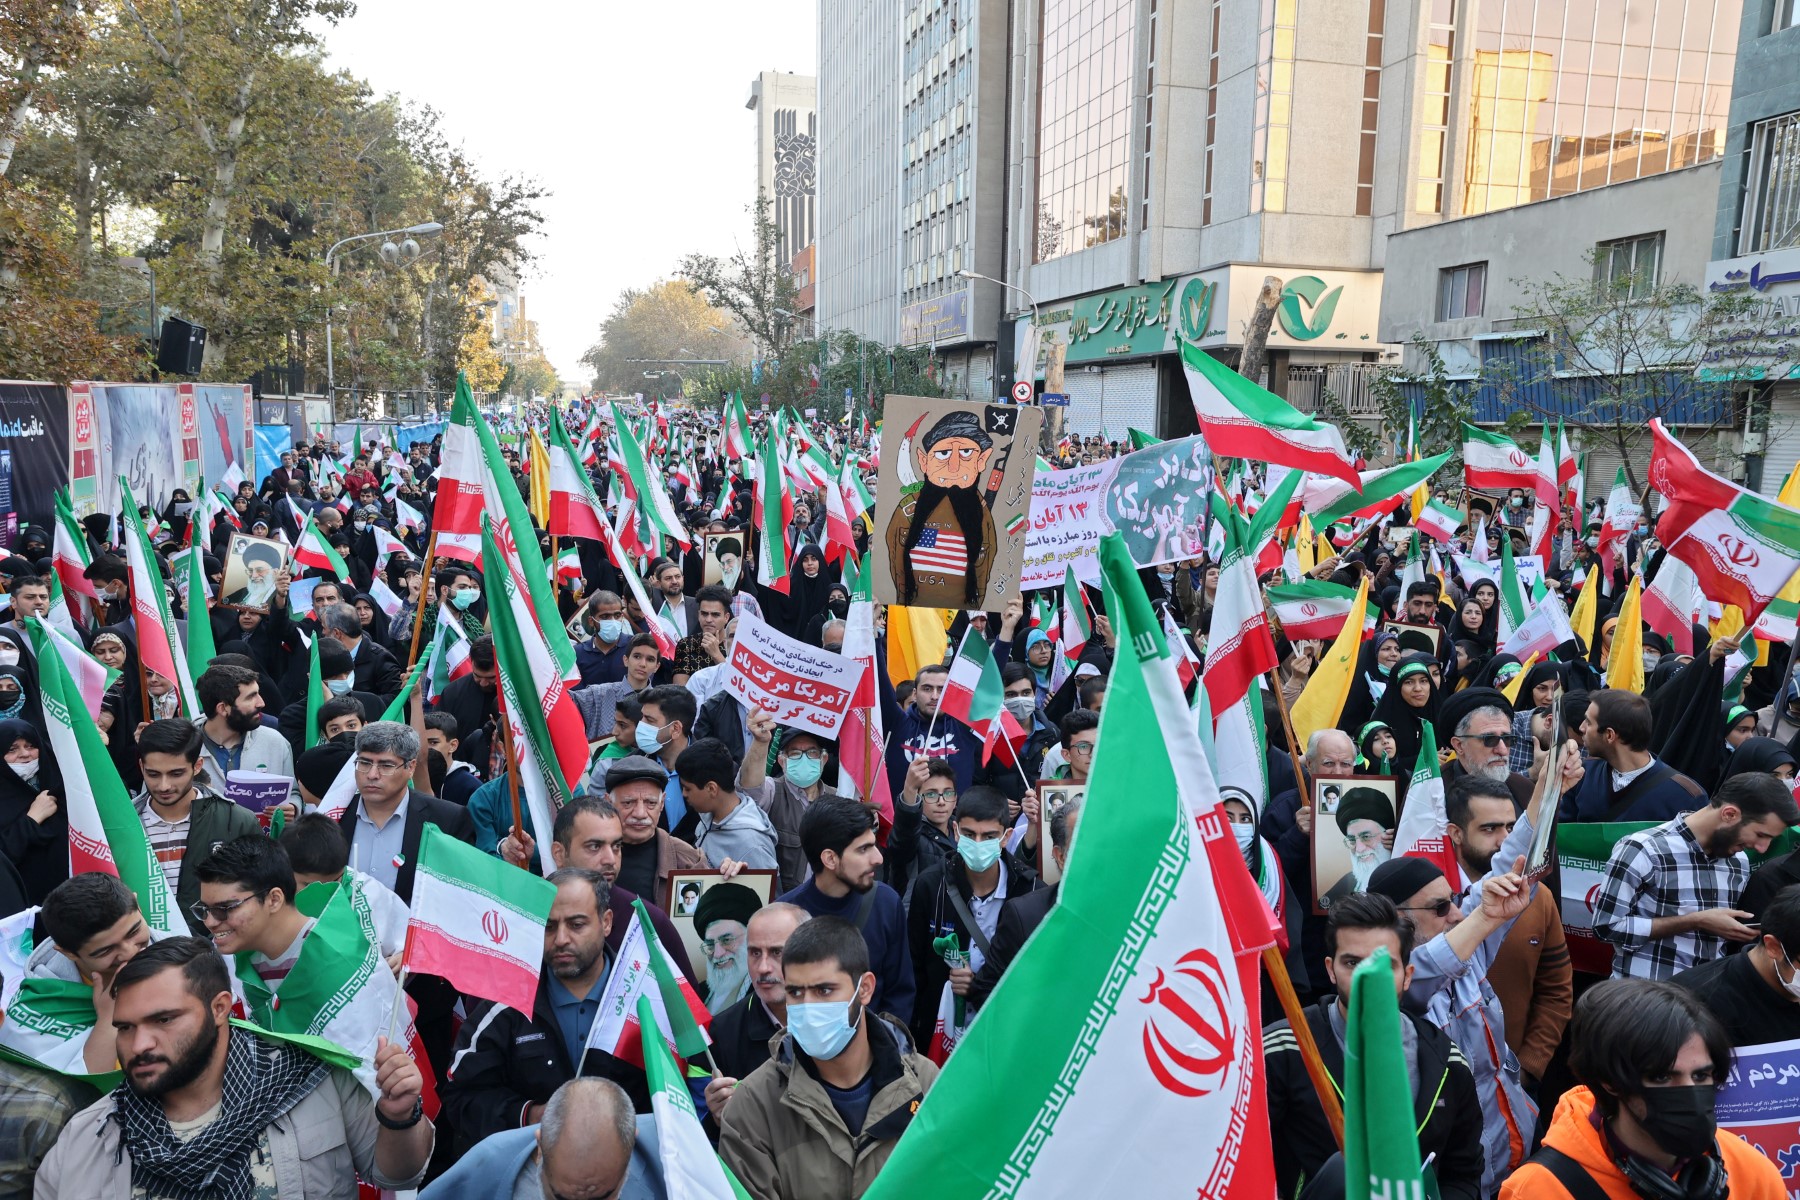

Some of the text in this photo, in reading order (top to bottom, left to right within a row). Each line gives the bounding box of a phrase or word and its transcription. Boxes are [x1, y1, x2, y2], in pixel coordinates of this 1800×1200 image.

[1057, 471, 1088, 490] آبان
[1034, 504, 1064, 530] آبان
[1042, 535, 1050, 547] با
[1051, 531, 1079, 545] مبارزه
[1081, 530, 1098, 541] روز
[918, 575, 946, 587] USA
[751, 627, 771, 644] آمریکا
[760, 648, 775, 661] است
[770, 642, 785, 655] هدف
[735, 651, 751, 674] باد
[785, 651, 816, 666] اقتصادی
[804, 667, 823, 679] ایجاد
[815, 661, 834, 672] جنگ
[833, 666, 843, 674] در
[730, 675, 746, 697] باد
[793, 680, 849, 707] آمریکا
[781, 705, 805, 720] گر
[806, 712, 836, 729] فتنه
[255, 786, 287, 799] سیلی
[1748, 1062, 1800, 1089] مردم
